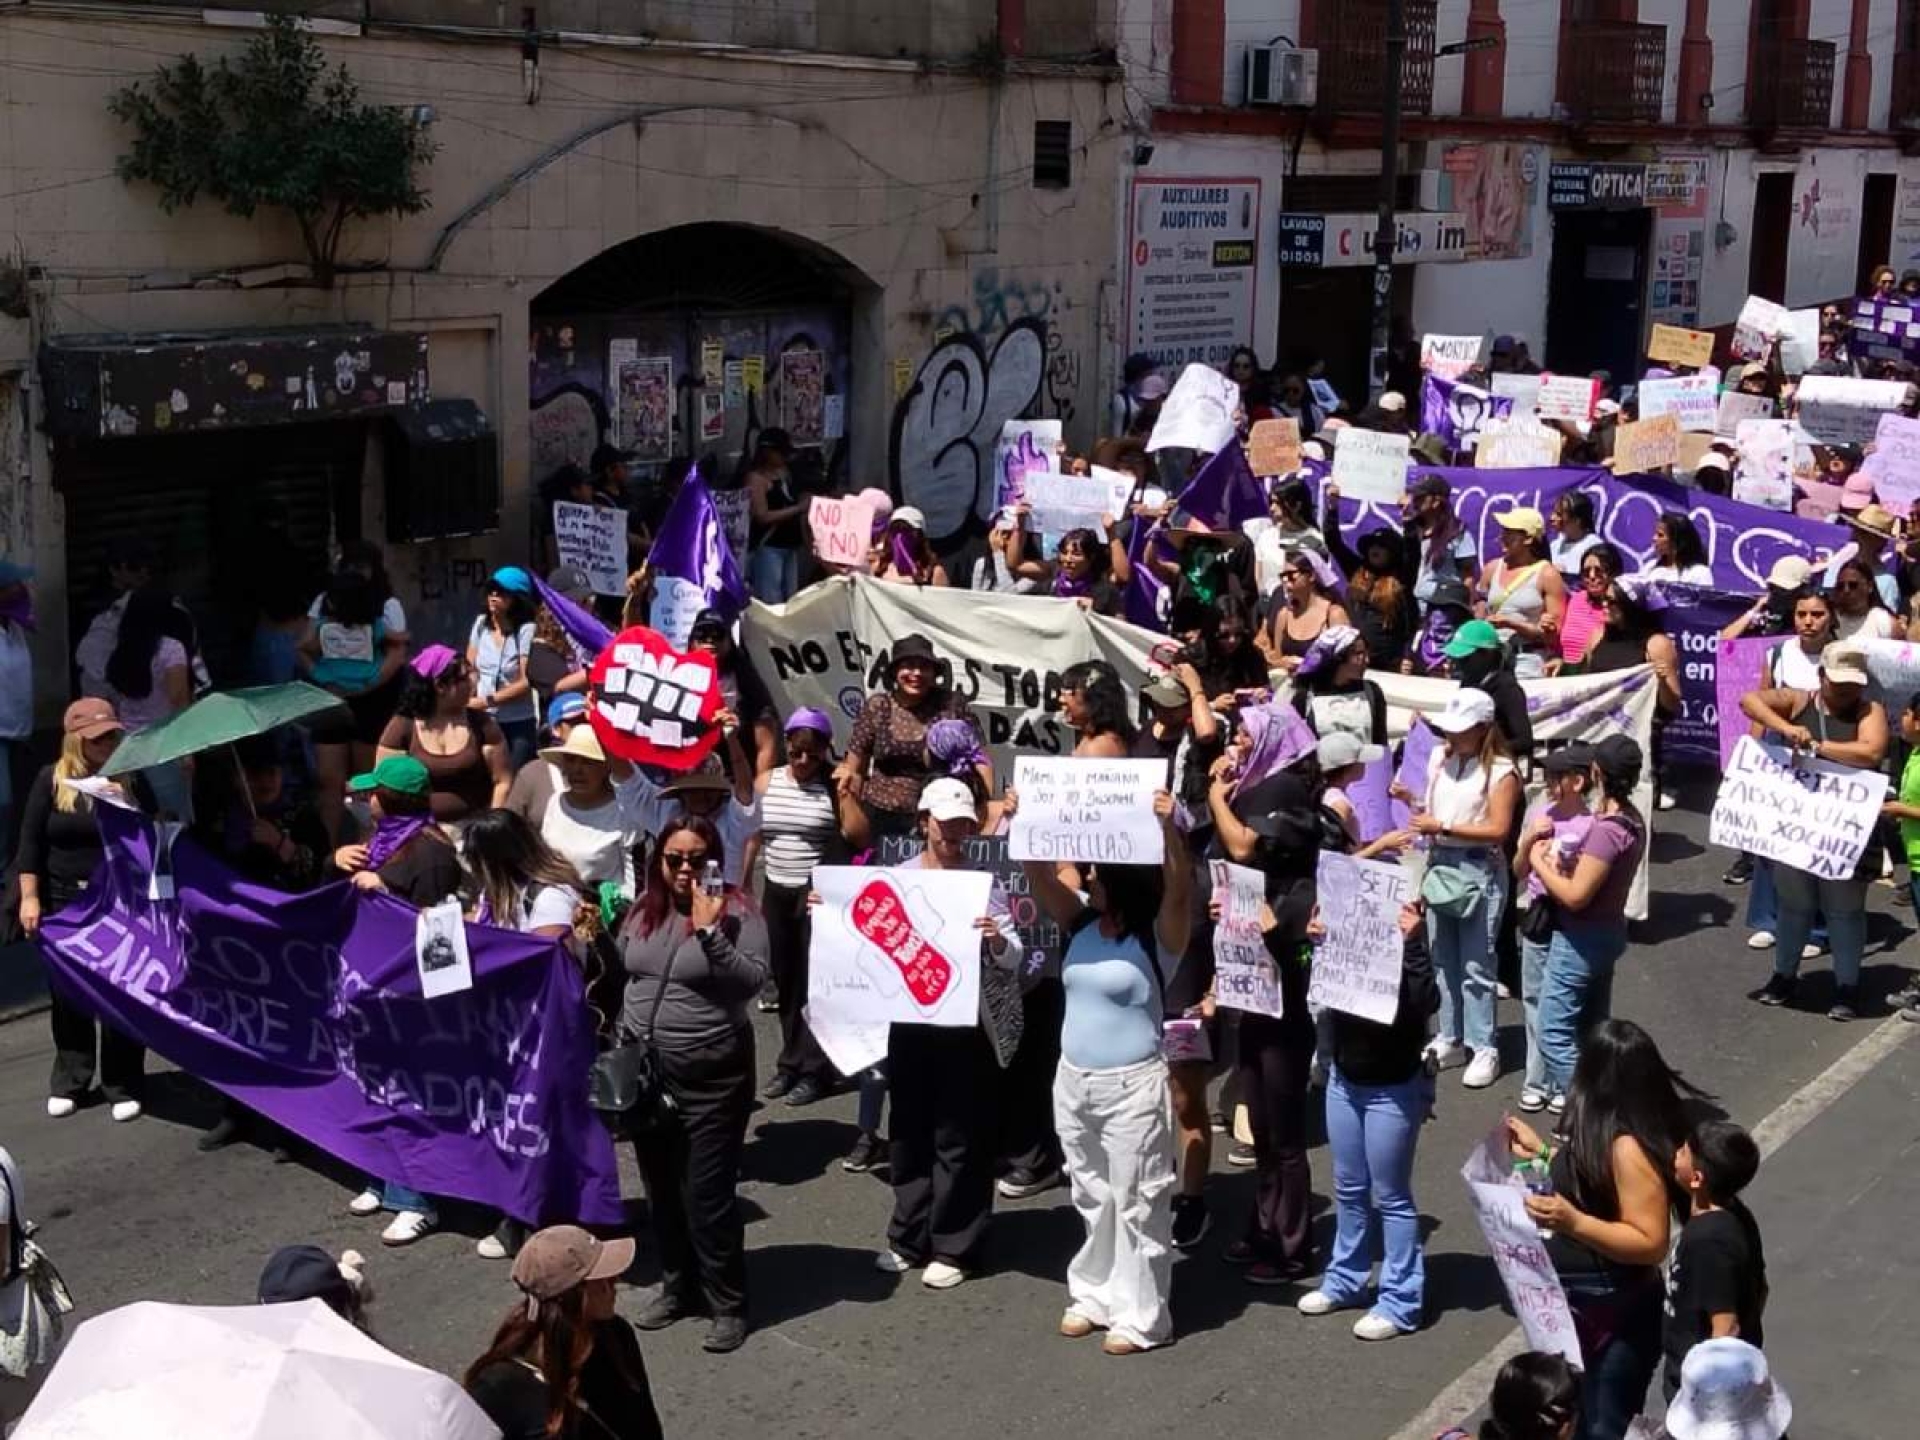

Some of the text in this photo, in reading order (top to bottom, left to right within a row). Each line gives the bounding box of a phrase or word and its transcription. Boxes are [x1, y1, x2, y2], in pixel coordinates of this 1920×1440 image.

[1552, 166, 1589, 175] EXAMEN
[1554, 180, 1585, 189] VISUAL
[1592, 173, 1642, 197] OPTICA
[1162, 189, 1229, 203] AUXILIARES
[1552, 194, 1585, 203] GRATIS
[1160, 211, 1227, 229] AUDITIVOS
[1282, 219, 1323, 230] LAVADO
[1294, 235, 1310, 246] DE
[1280, 251, 1320, 263] OIDOS
[816, 503, 842, 526] NO
[831, 532, 858, 557] NO
[770, 640, 829, 680] NO
[1029, 826, 1133, 860] ESTRELLAS
